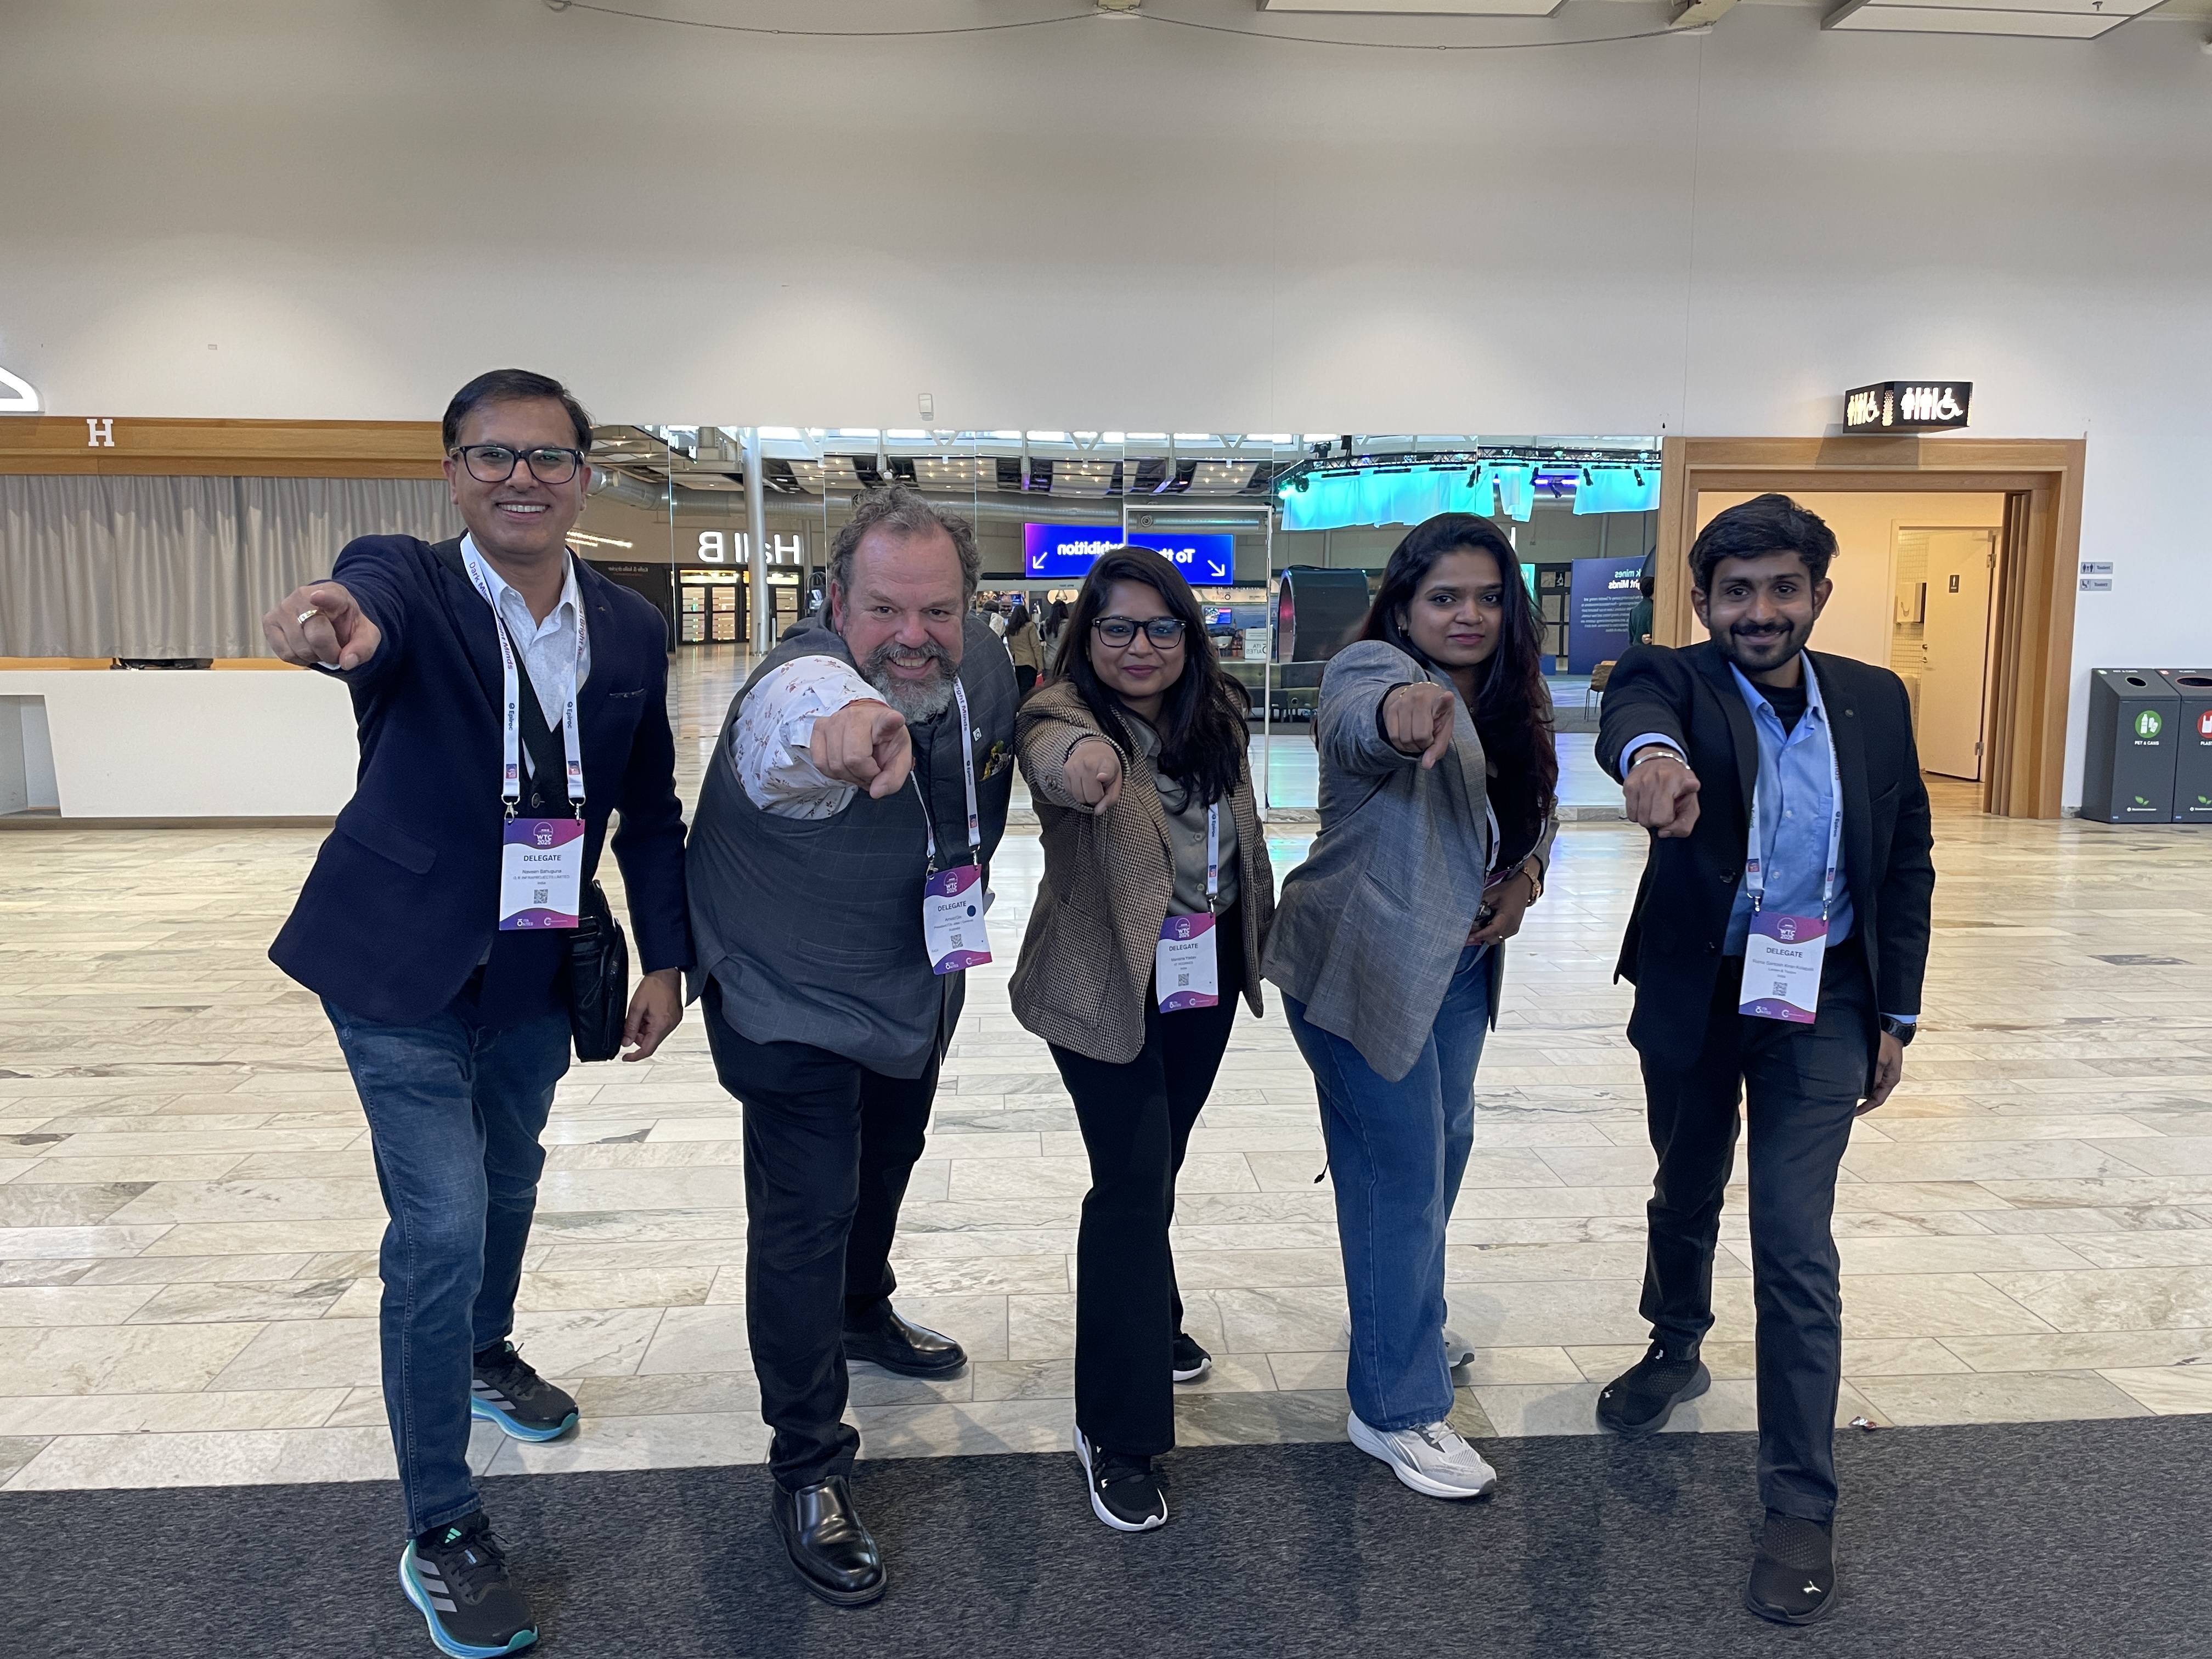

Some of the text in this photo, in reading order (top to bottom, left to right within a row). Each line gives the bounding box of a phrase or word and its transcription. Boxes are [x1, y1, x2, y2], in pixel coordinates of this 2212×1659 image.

[87, 419, 115, 448] H
[469, 562, 481, 583] Dark
[503, 641, 514, 670] Minds
[938, 901, 967, 911] DELEGATE
[1169, 943, 1199, 951] DELEGATE
[1767, 947, 1803, 958] DELEGATE
